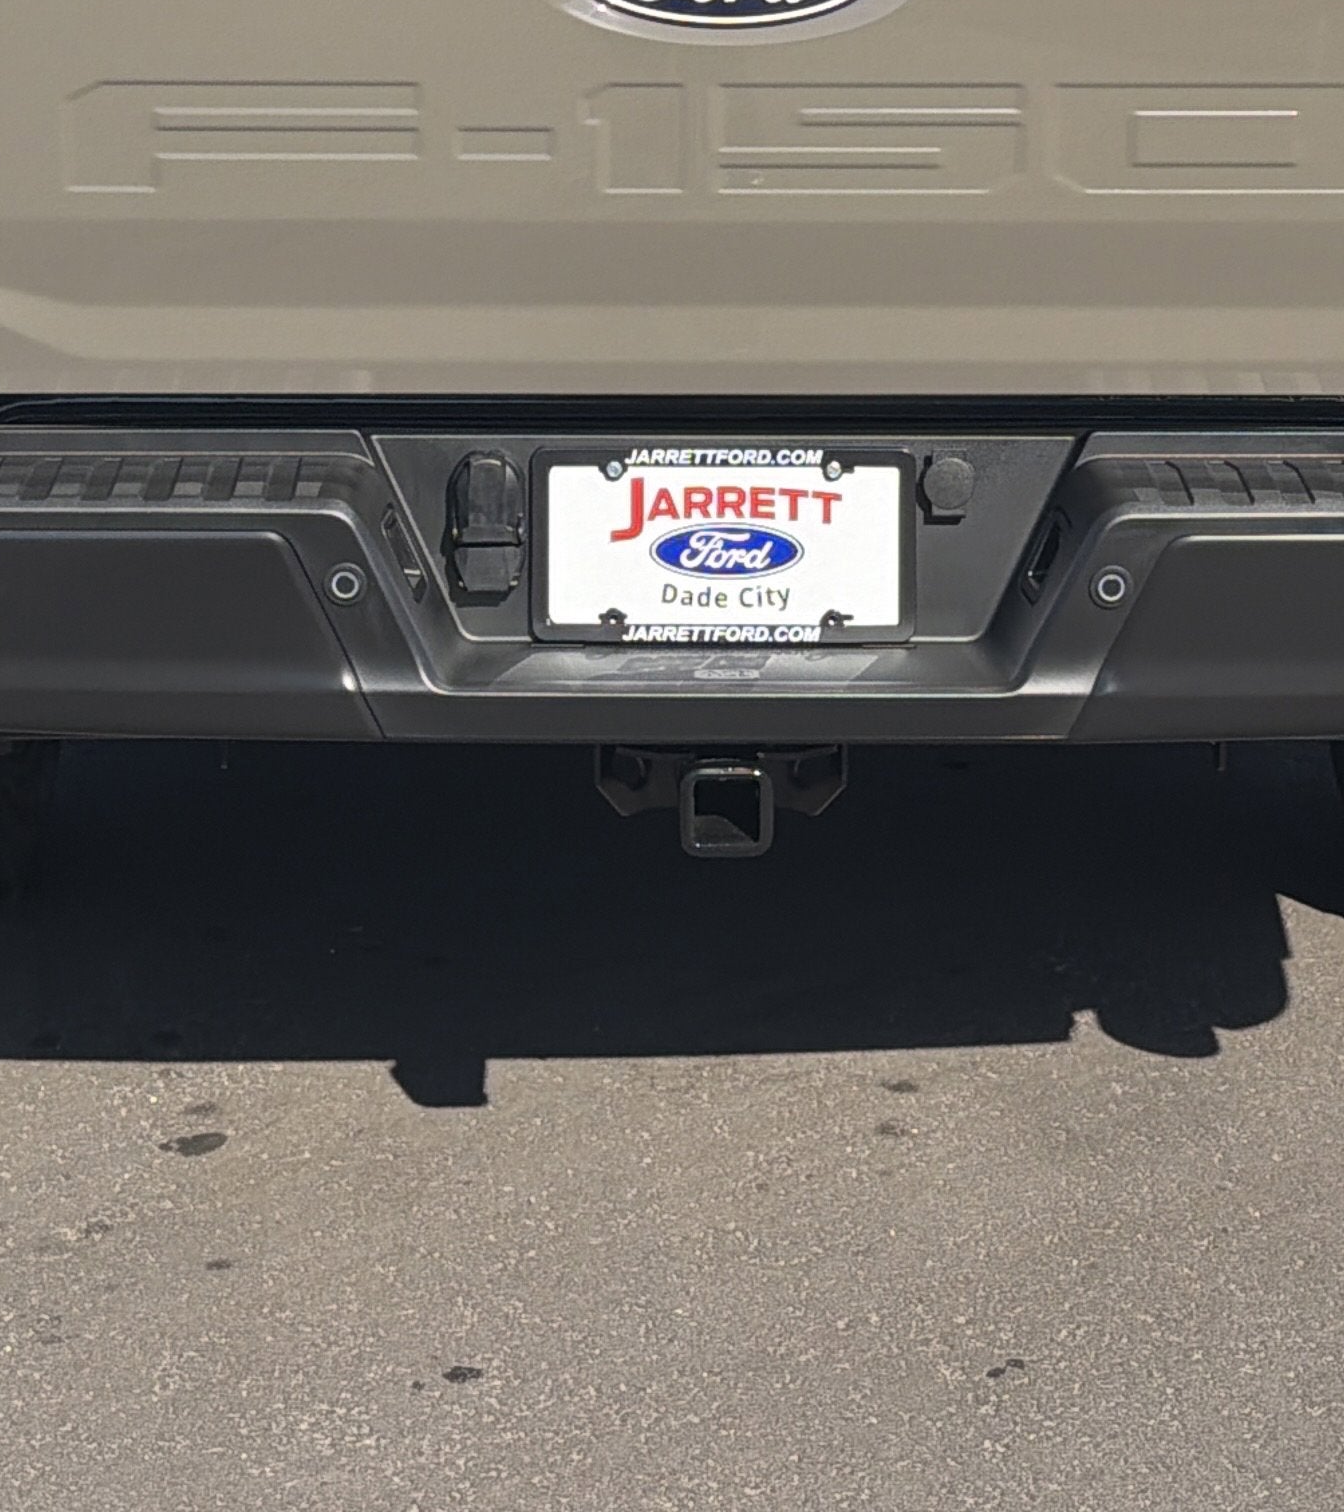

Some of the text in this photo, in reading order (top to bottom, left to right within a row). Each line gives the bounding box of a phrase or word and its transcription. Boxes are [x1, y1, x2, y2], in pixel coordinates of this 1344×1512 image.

[624, 449, 824, 466] JARRETTFORD.COM
[610, 477, 842, 543] JARRETT
[680, 530, 771, 570] Ford
[661, 584, 790, 611] Dade City
[622, 625, 821, 643] JARRETTFORD.COM
